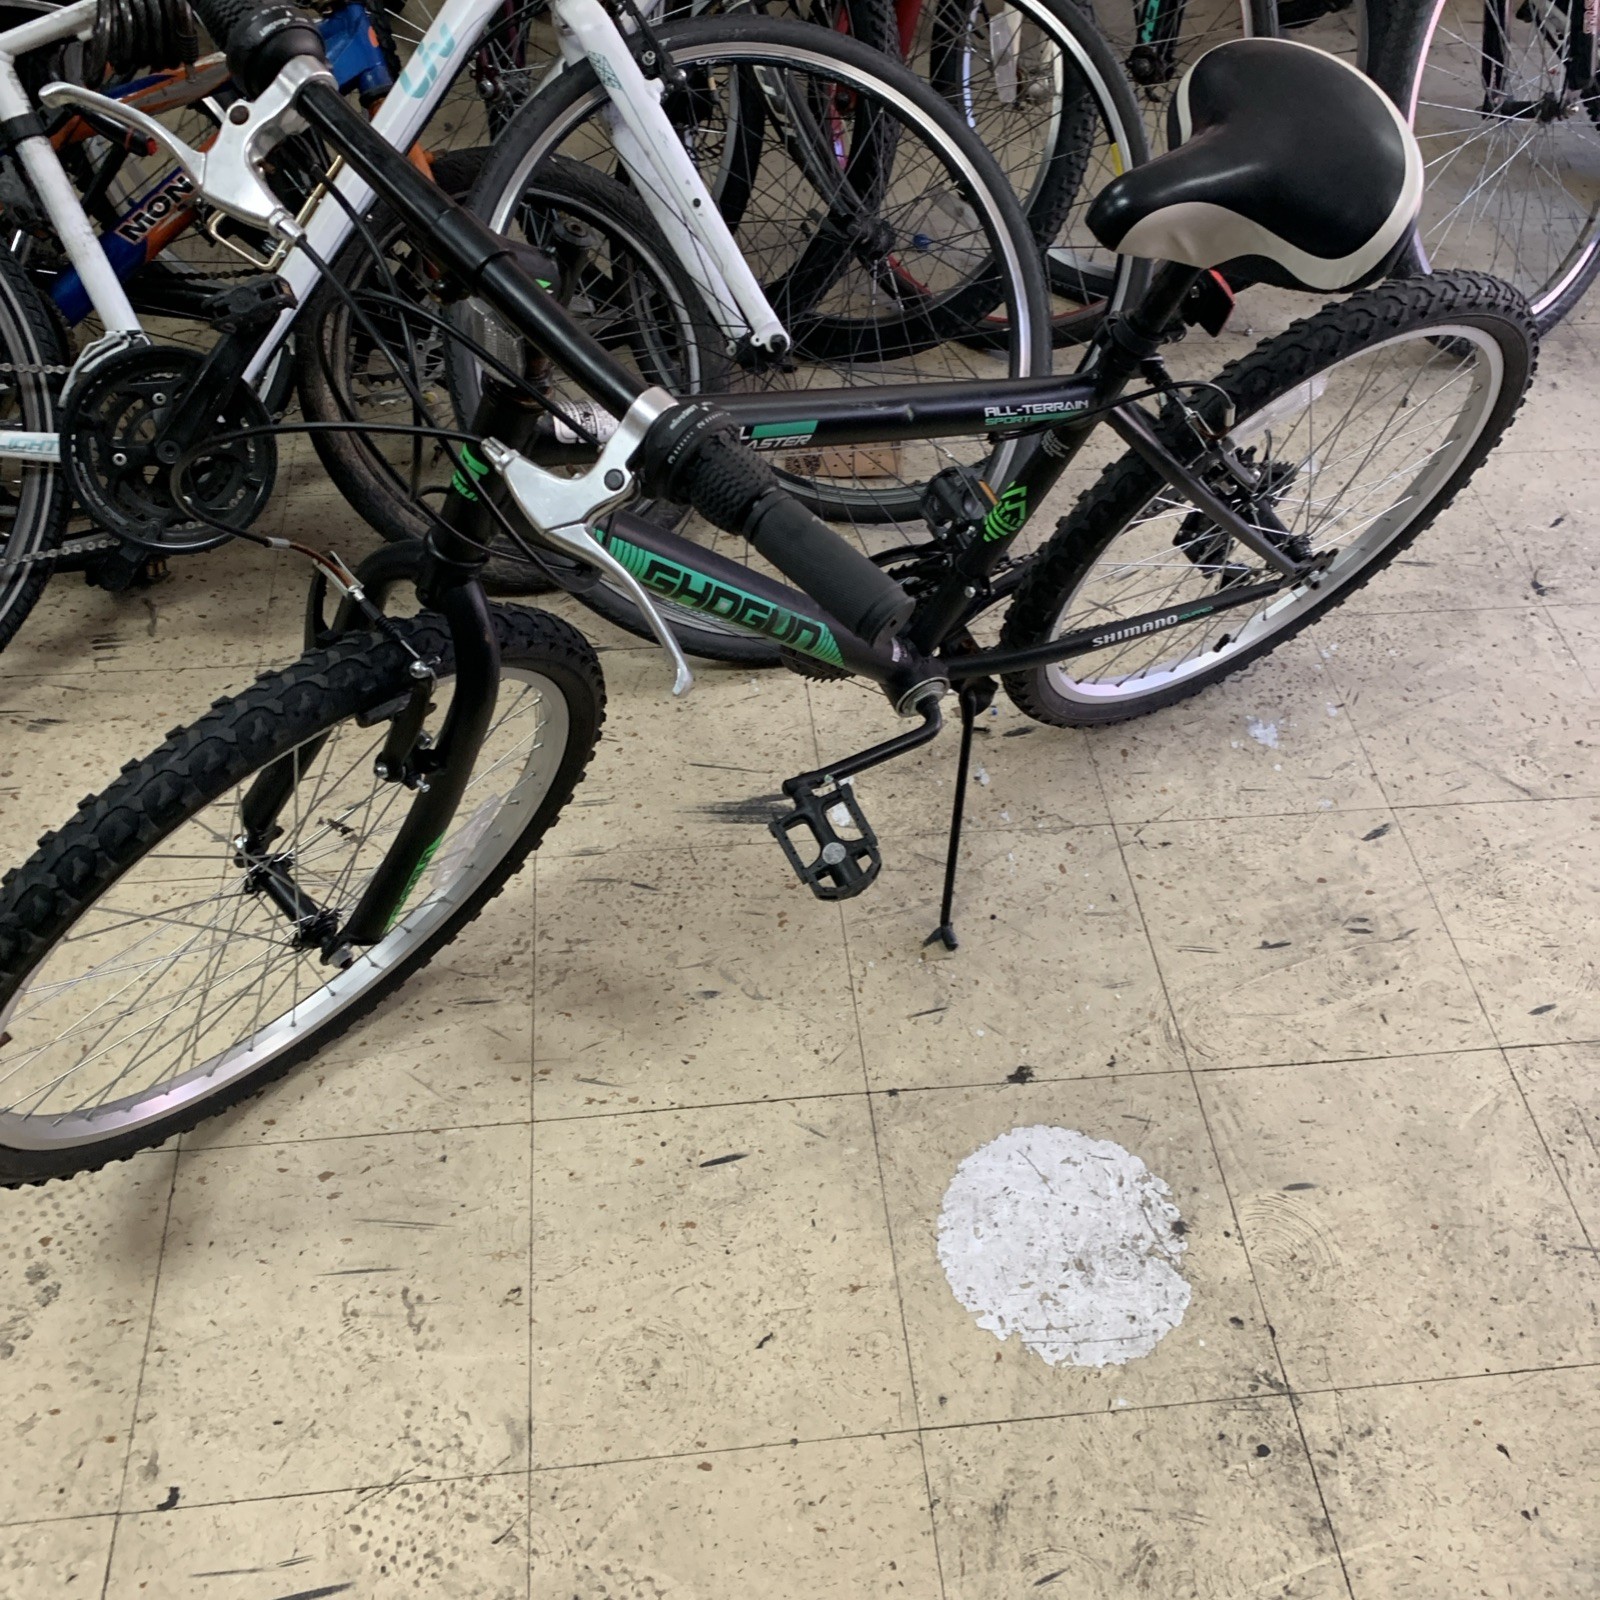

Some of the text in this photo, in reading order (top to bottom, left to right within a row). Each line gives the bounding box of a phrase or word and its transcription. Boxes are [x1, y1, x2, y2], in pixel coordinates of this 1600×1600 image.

[984, 400, 1089, 417] ALL-TERRAIN
[746, 434, 813, 449] ASTER
[1092, 614, 1178, 647] SHIMANO
